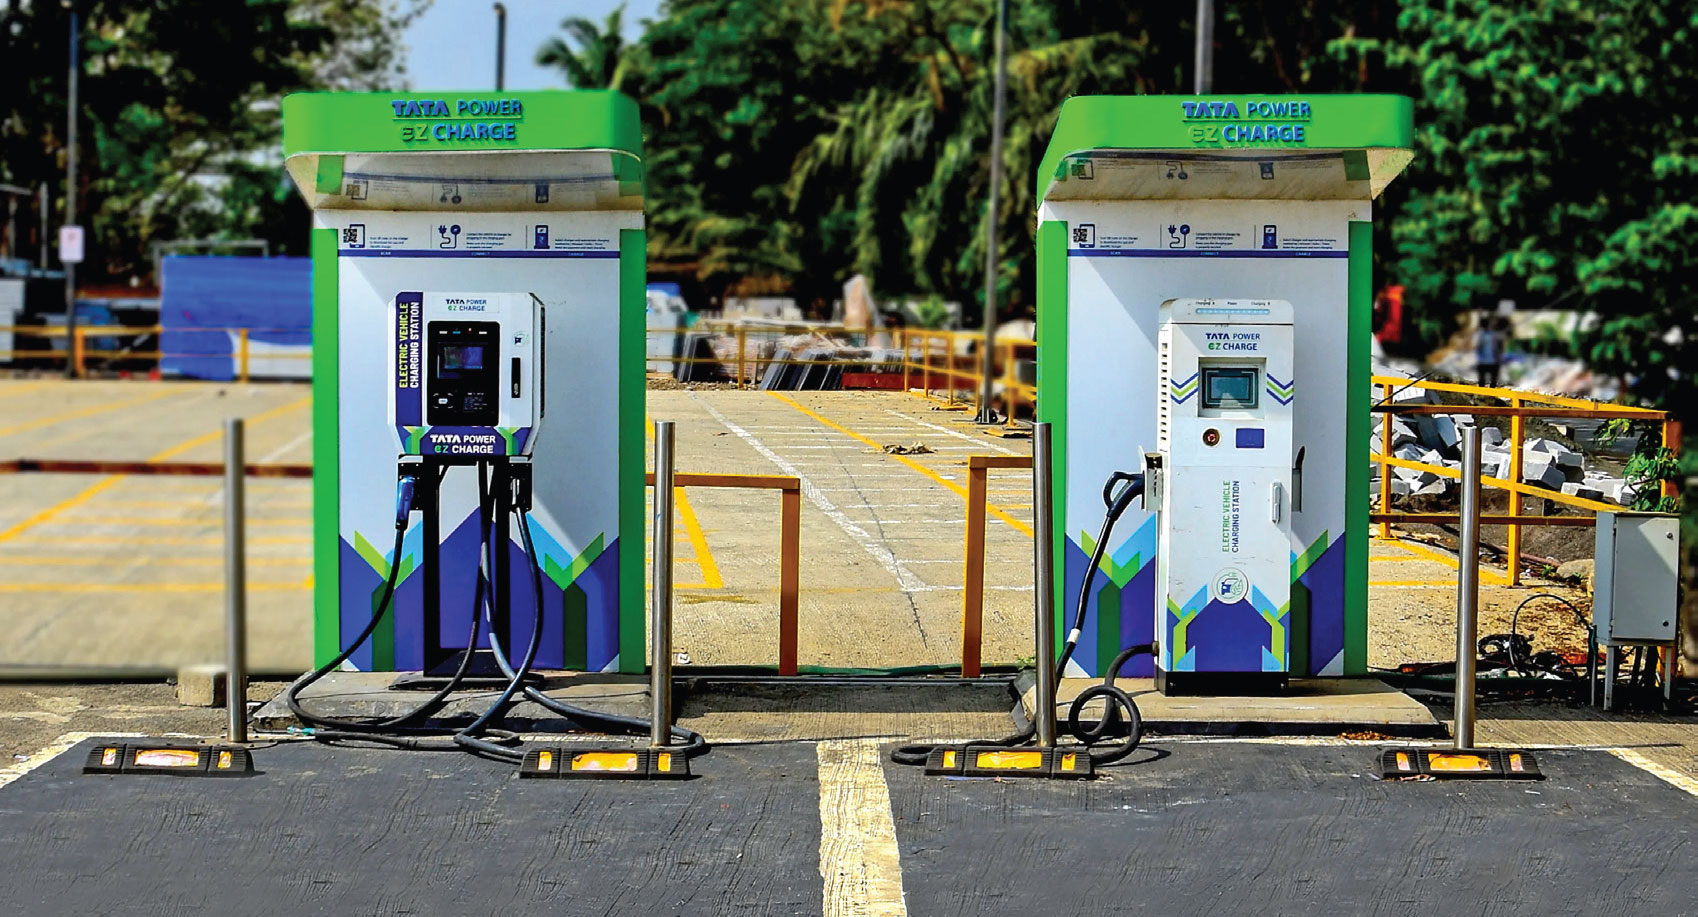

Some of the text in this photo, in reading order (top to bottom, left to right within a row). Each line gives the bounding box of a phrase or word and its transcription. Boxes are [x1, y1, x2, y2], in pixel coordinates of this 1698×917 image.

[391, 98, 522, 116] TATA POWER
[1182, 101, 1311, 118] TATA POWER
[432, 122, 516, 140] CHARGE
[1222, 124, 1305, 142] CHARGE
[399, 303, 409, 388] ELECTRIC VEHICLE
[410, 301, 420, 388] CHARGING STATION
[1222, 342, 1258, 350] CHARGE
[430, 434, 496, 443] TATA POWER
[452, 445, 494, 454] CHARGE
[1222, 480, 1231, 553] ELECTRIC VEHICLE
[1231, 480, 1240, 553] CHARGING STATION
